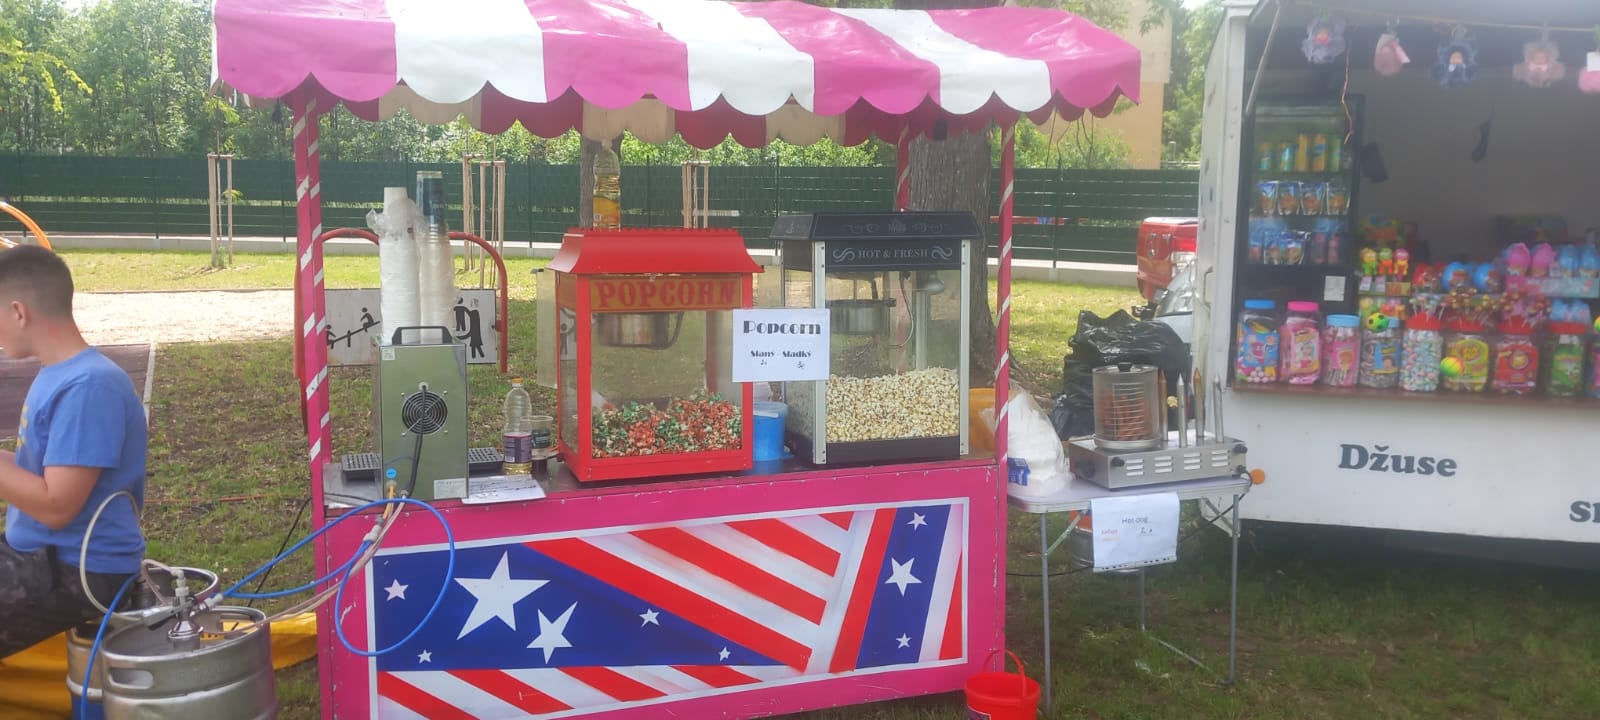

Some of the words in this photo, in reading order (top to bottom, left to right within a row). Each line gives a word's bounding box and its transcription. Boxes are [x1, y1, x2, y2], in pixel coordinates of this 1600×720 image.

[858, 249, 881, 259] HOT
[882, 249, 890, 258] &
[893, 248, 928, 259] FRESH
[594, 280, 737, 307] POPCORN
[743, 320, 821, 335] Popcorn
[1338, 444, 1457, 477] Džuse
